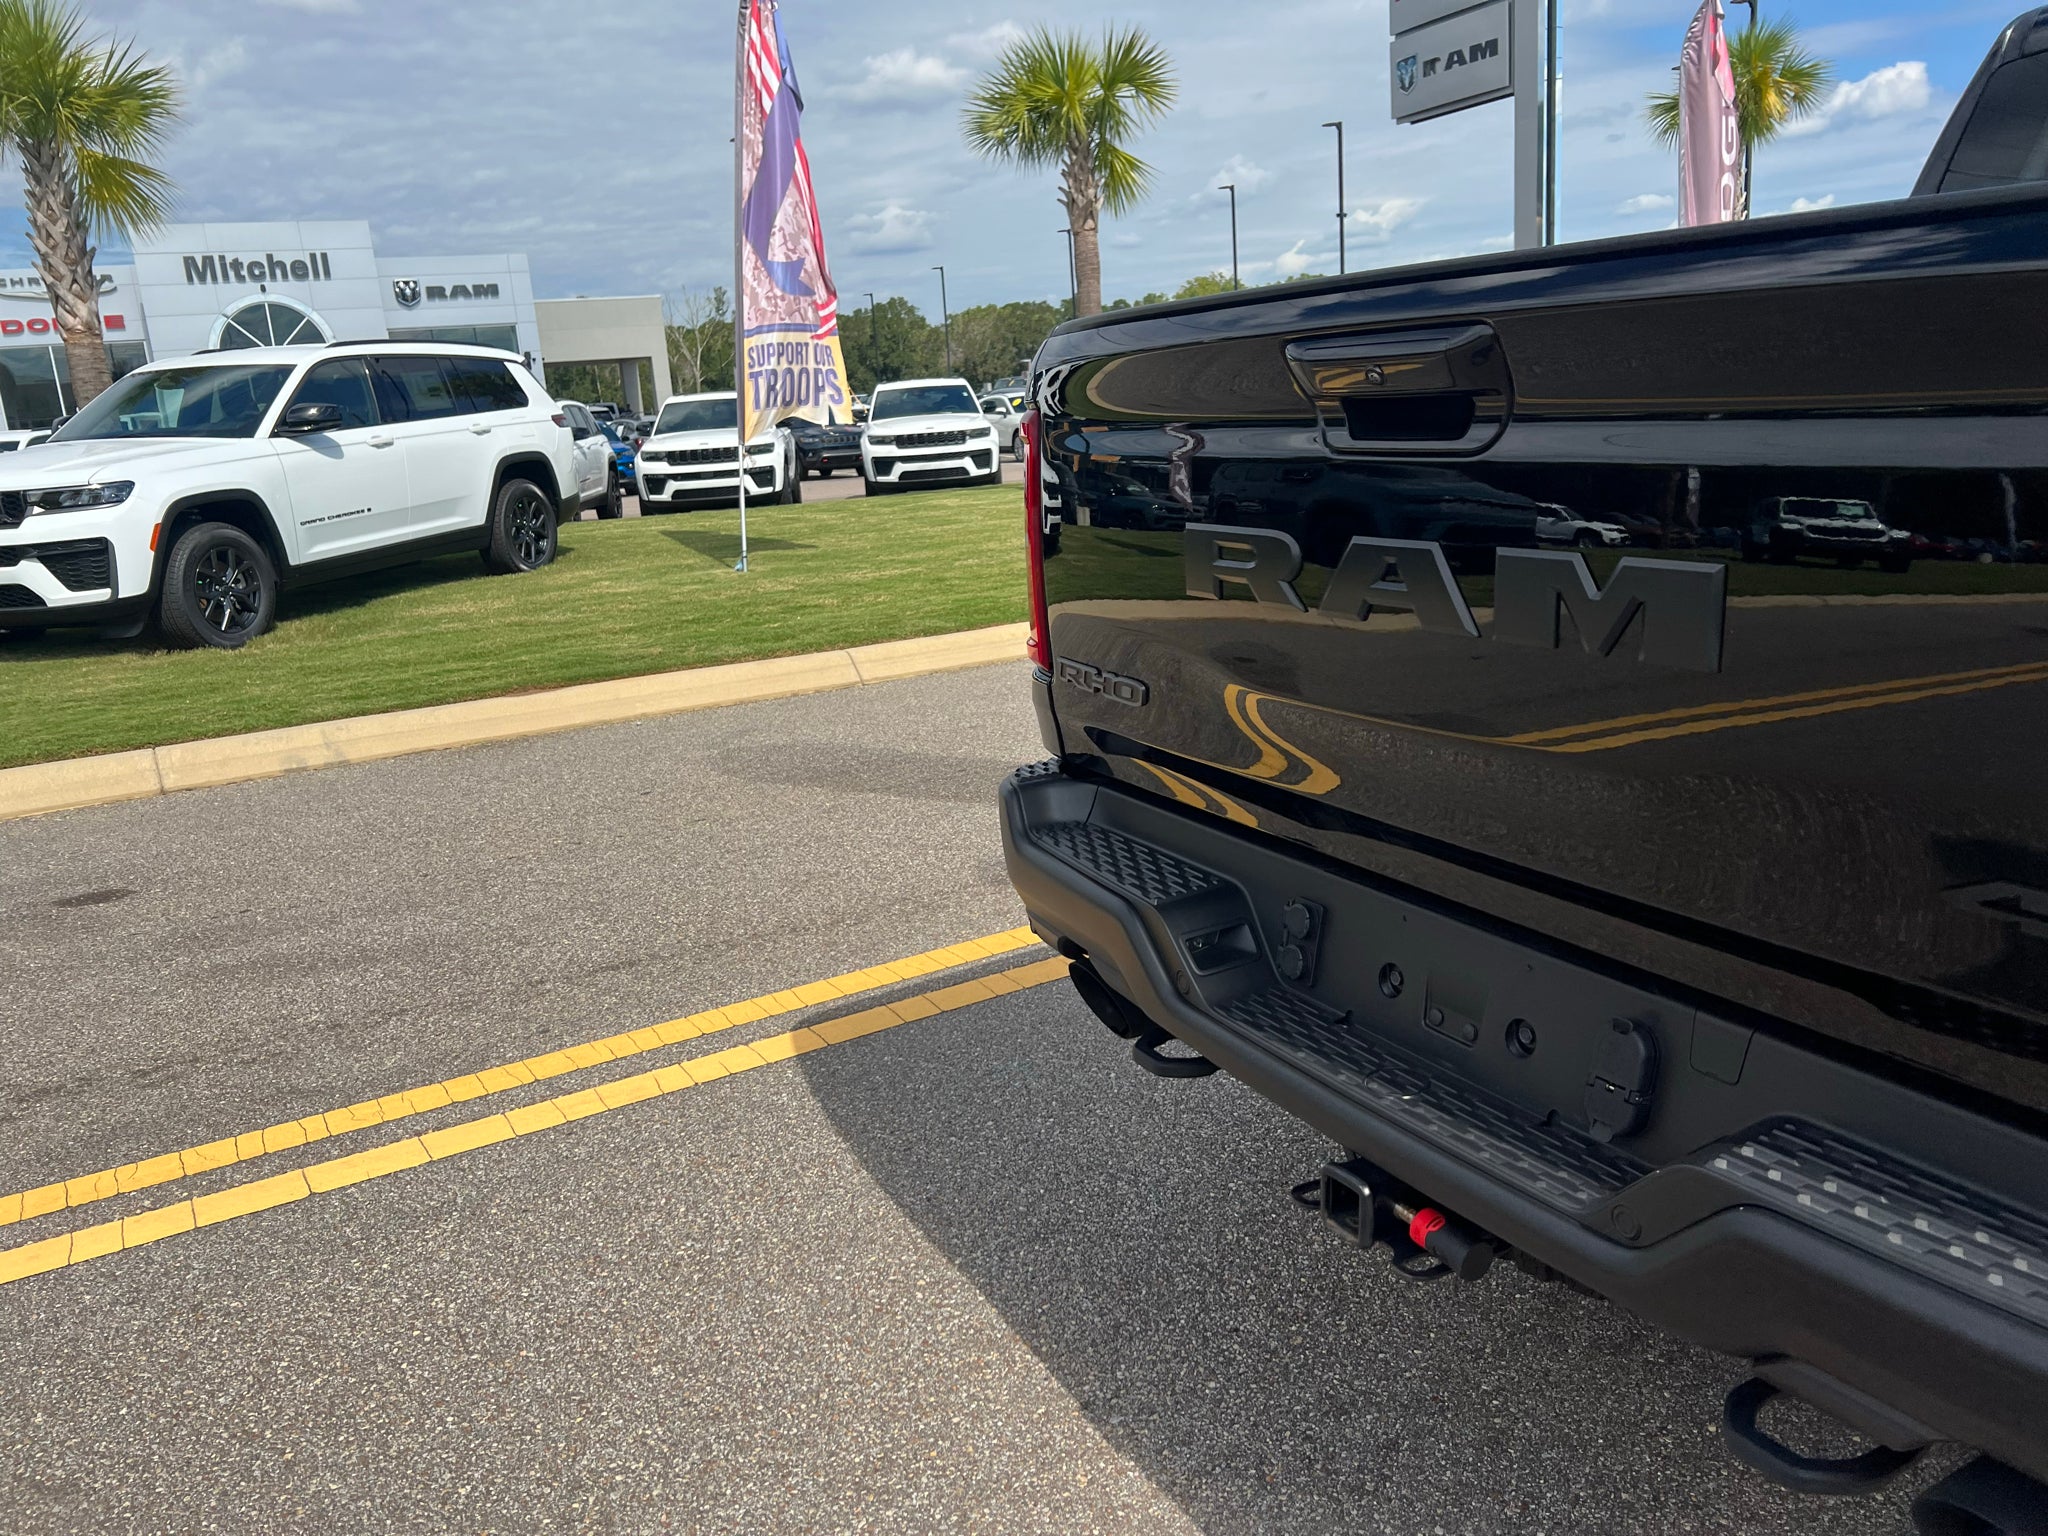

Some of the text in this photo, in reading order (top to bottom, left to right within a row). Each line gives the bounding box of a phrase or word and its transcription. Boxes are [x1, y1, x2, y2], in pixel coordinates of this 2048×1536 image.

[1422, 38, 1499, 78] RAM
[182, 252, 332, 286] Mitchell
[425, 283, 500, 301] RAM
[0, 314, 126, 335] DOE
[748, 342, 810, 369] SUPPORT
[749, 367, 844, 411] TROOPS
[1185, 521, 1727, 674] RAM
[1057, 655, 1149, 707] RHO
